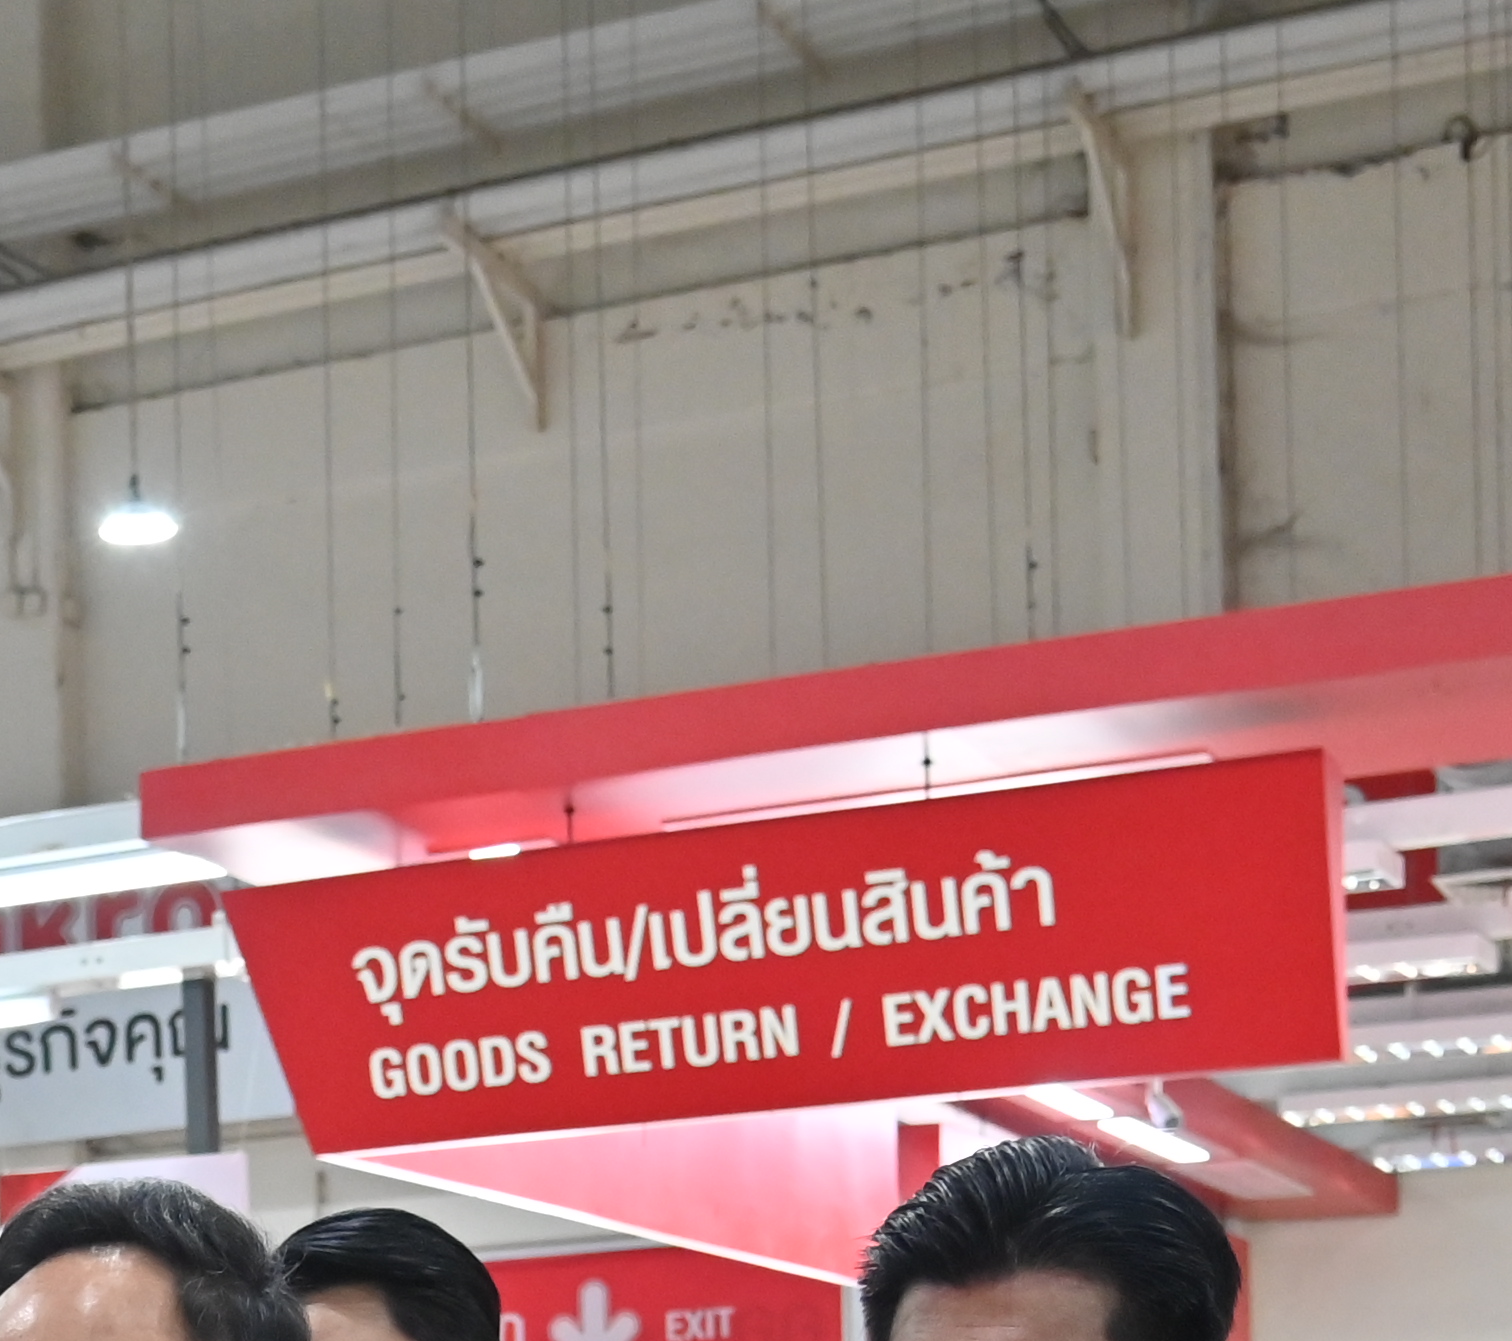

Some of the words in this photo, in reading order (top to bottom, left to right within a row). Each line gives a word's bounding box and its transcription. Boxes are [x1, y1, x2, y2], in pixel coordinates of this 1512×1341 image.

[351, 848, 1057, 1028] จุดรับคืน/เปลี่ยนสินค้า
[369, 1032, 552, 1102] GOODS
[580, 1001, 801, 1080] RETURN
[830, 998, 852, 1060] /
[882, 963, 1192, 1052] EXCHANGE
